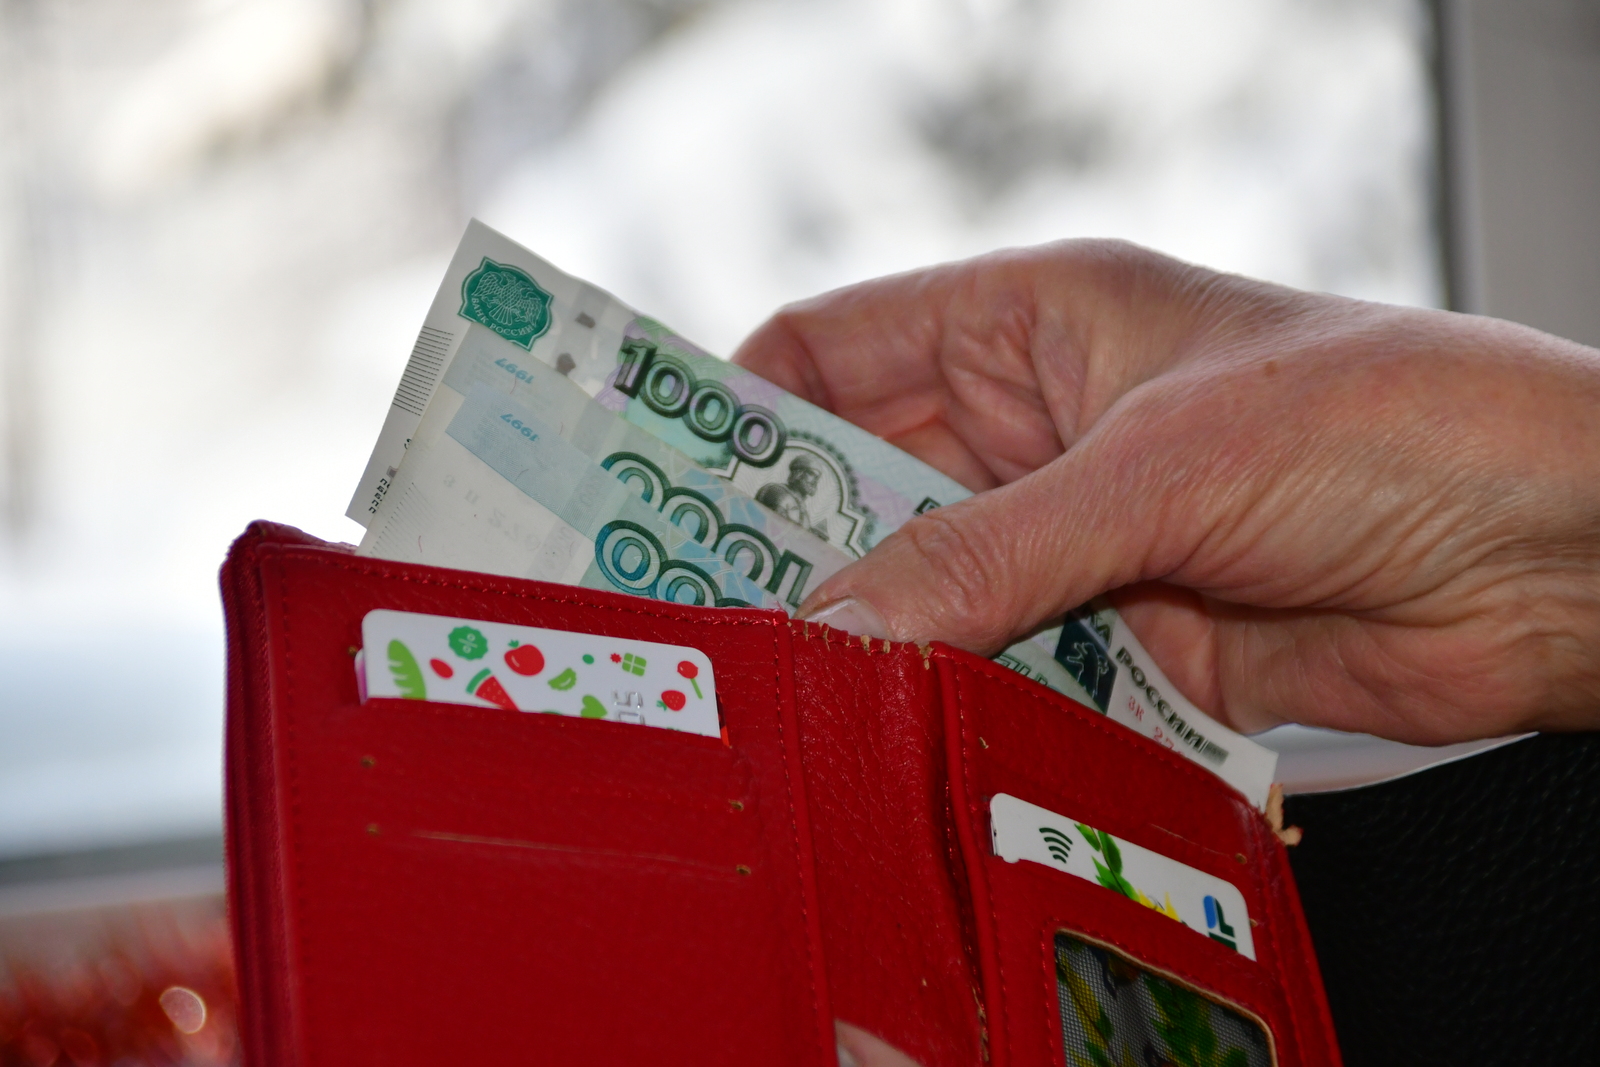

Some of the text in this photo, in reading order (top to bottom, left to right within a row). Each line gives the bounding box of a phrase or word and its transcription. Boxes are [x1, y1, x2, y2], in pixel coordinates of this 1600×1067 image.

[471, 297, 535, 336] БАНК РОССИИ
[494, 358, 534, 384] 1997
[613, 334, 787, 468] 1000
[500, 413, 539, 441] 1997
[1116, 646, 1209, 754] РОССИИ
